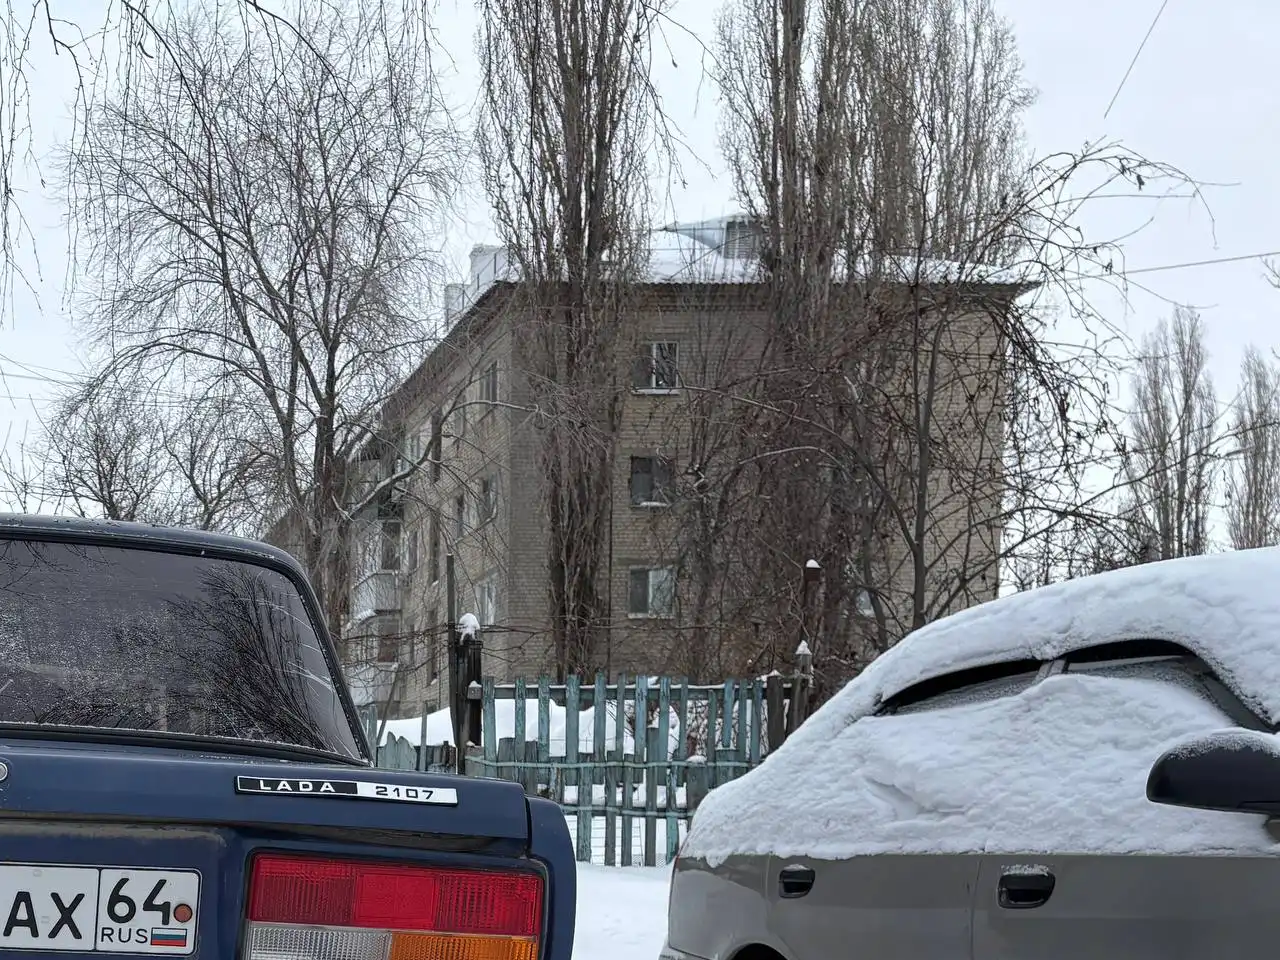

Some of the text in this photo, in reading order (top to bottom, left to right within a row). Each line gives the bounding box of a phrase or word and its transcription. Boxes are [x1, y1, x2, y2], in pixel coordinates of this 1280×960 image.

[259, 779, 434, 800] LADA 2107
[106, 877, 170, 926] 64
[100, 926, 149, 944] RUS
